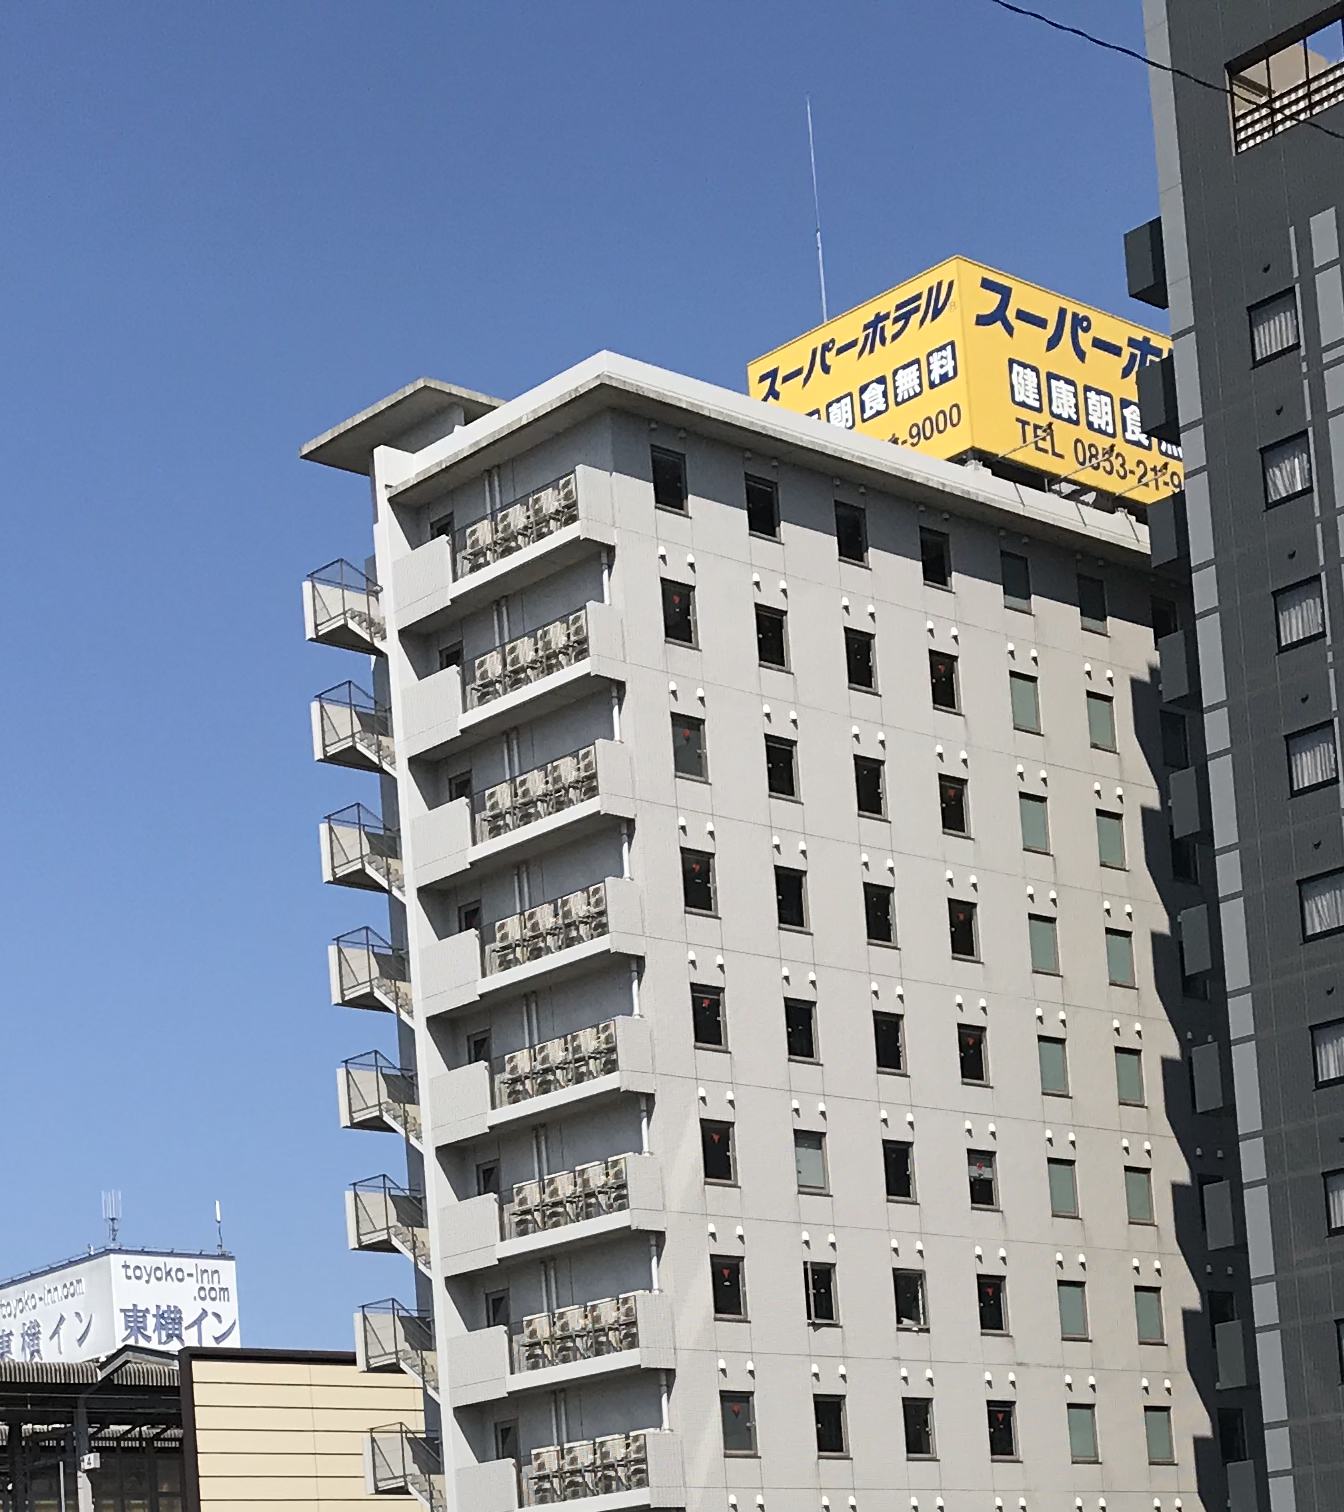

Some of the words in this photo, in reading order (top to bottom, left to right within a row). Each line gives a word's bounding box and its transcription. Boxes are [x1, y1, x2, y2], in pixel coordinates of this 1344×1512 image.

[758, 280, 954, 402] スーパーホテル
[975, 277, 1173, 380] スーパーホ
[807, 343, 955, 430] 朝食無料
[1011, 361, 1183, 460] 健康朝食
[1016, 417, 1065, 459] TEL
[120, 1303, 236, 1347] 東横イン
